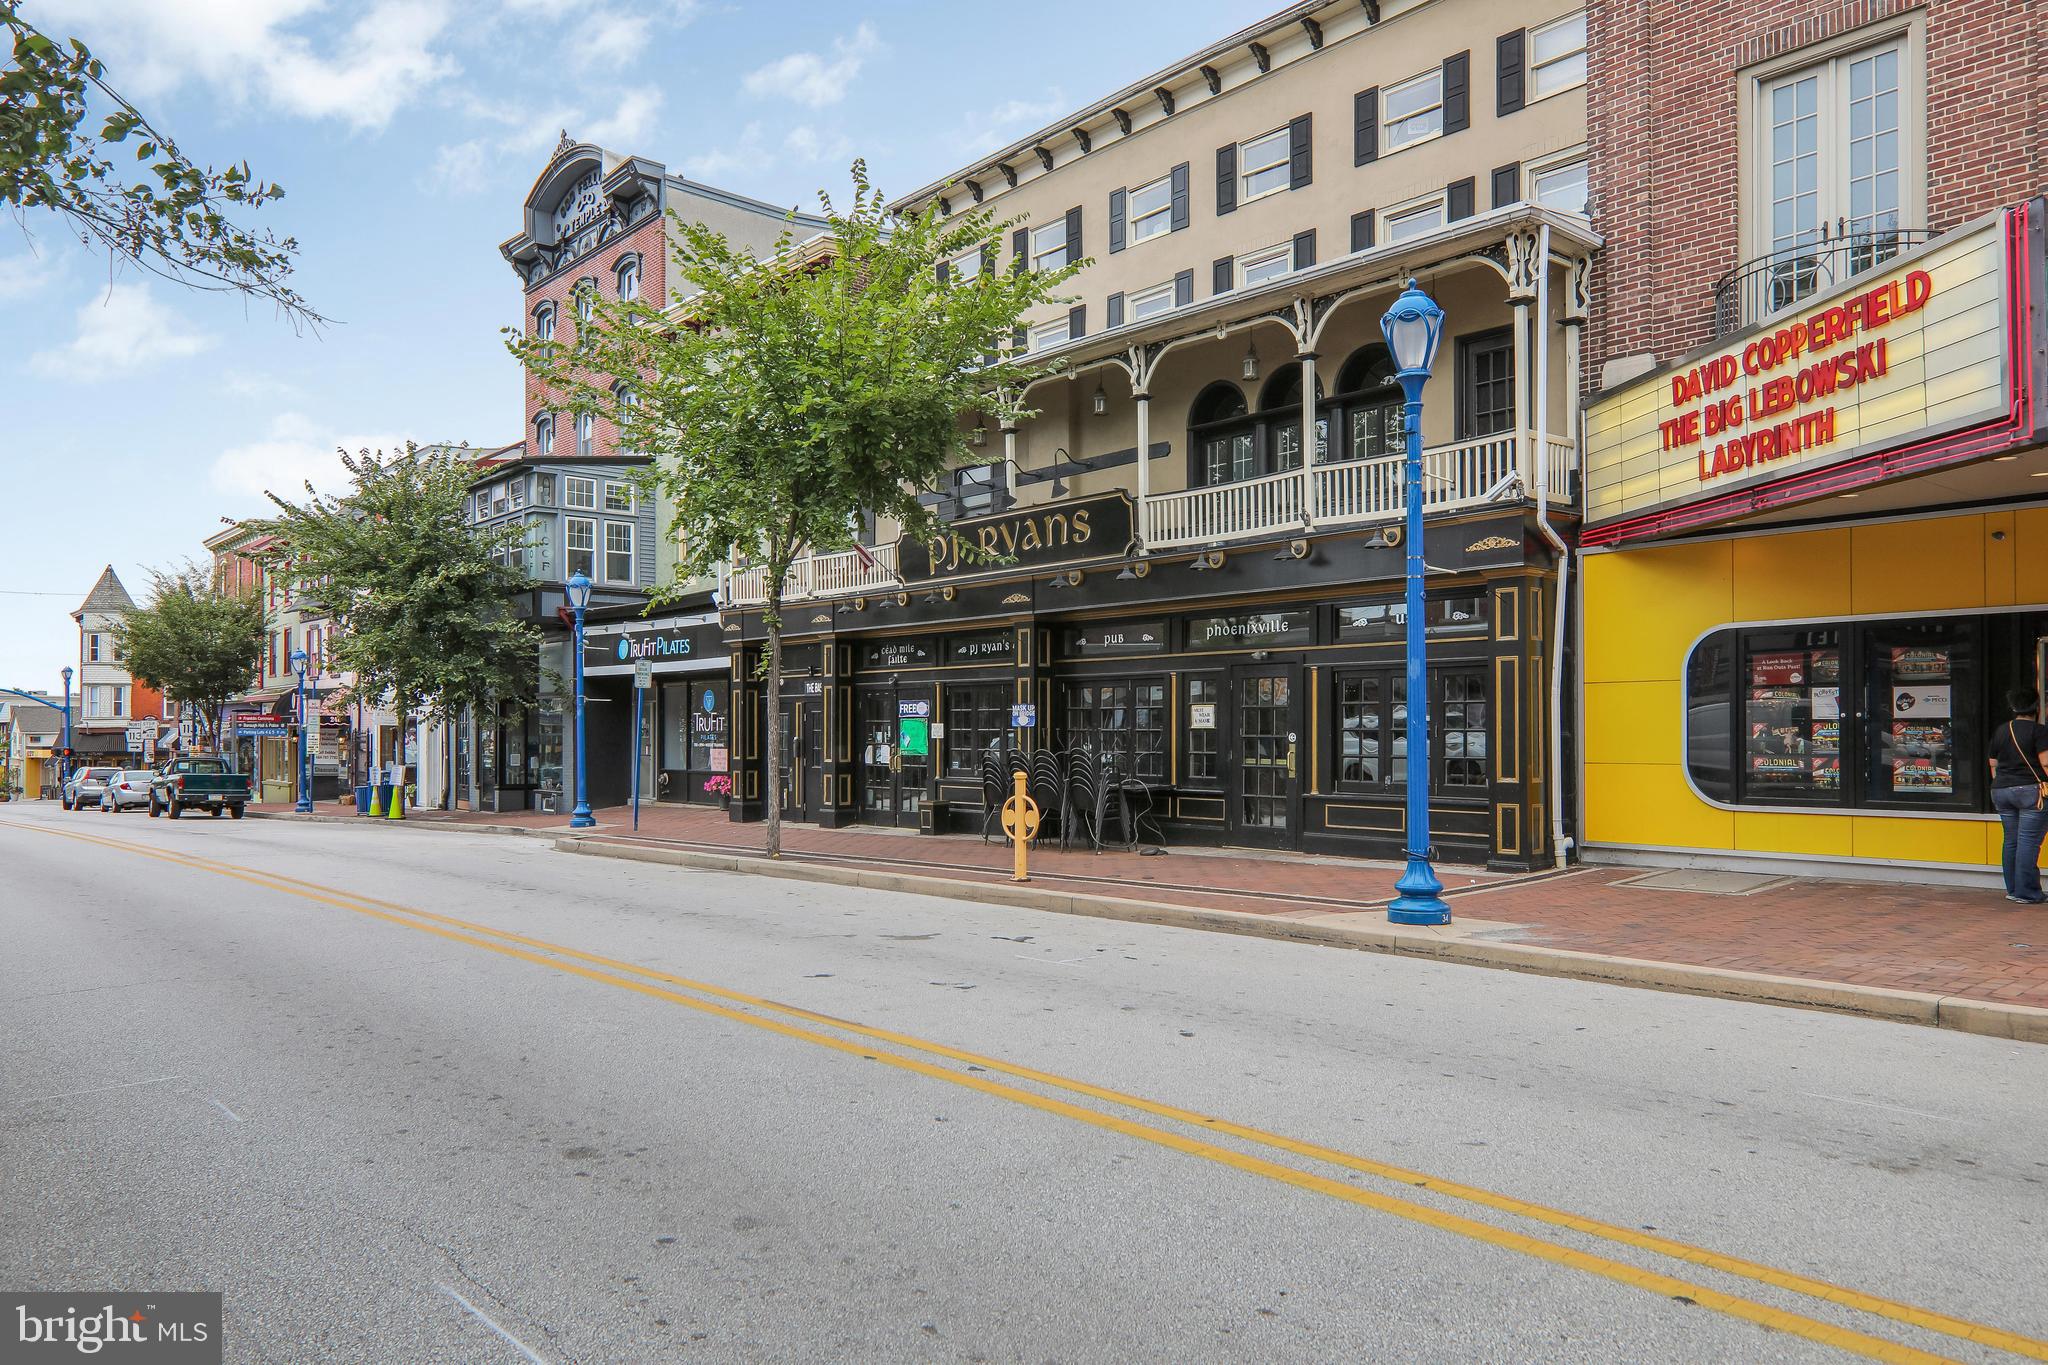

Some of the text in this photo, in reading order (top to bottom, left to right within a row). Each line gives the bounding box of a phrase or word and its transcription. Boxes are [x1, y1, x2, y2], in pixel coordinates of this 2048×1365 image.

[1672, 270, 1931, 407] DAVID COPPERFIELD
[1659, 338, 1887, 451] THE BIG LEBOWSKI
[1699, 407, 1834, 481] LABYRINTH
[1206, 620, 1289, 640] phoenixville
[656, 637, 690, 655] PILATES
[969, 640, 1010, 655] PJ Ryan's
[1104, 633, 1125, 647] pub
[806, 683, 814, 693] THE
[900, 704, 917, 713] FREE
[129, 732, 141, 740] 113
